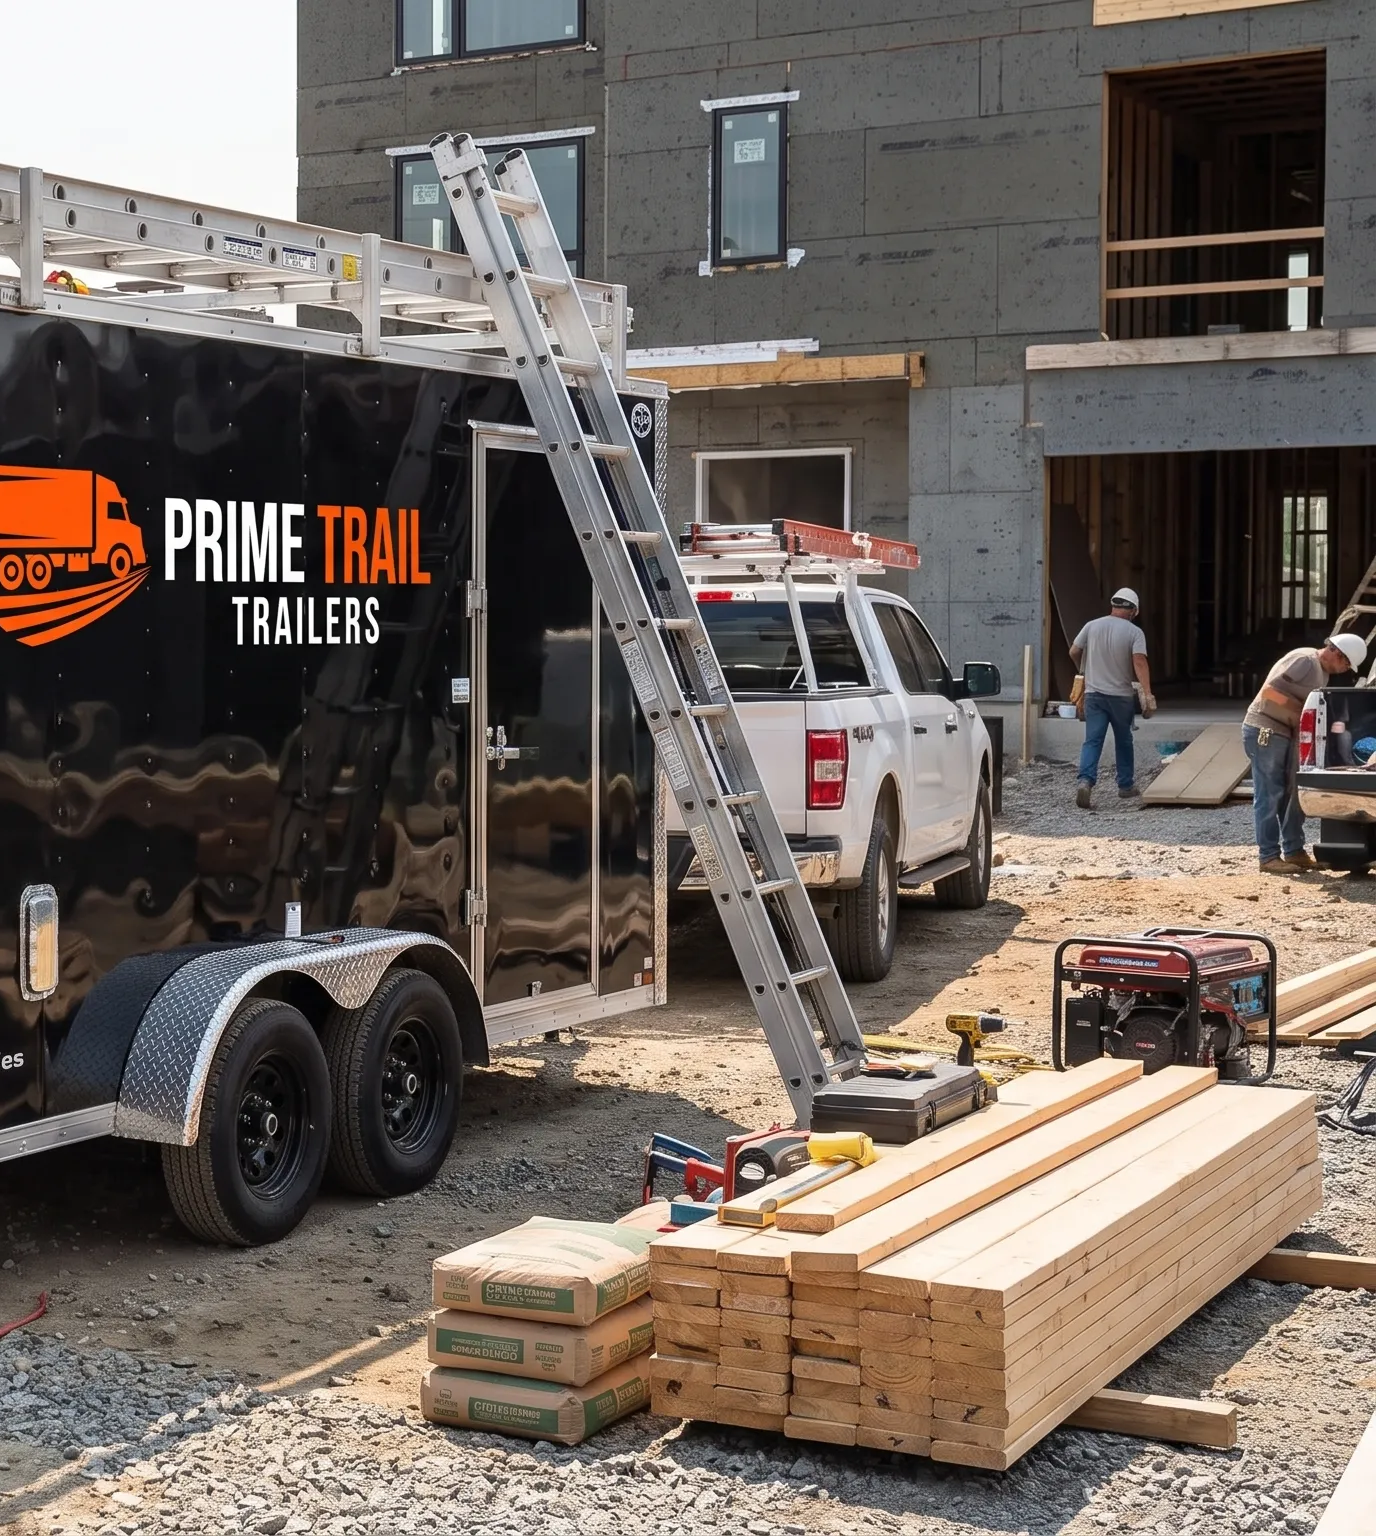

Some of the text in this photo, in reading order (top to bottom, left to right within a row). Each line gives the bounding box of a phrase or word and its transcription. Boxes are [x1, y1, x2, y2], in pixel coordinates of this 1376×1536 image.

[165, 497, 431, 584] PRIME TRAIL
[232, 596, 380, 645] TRAILERS
